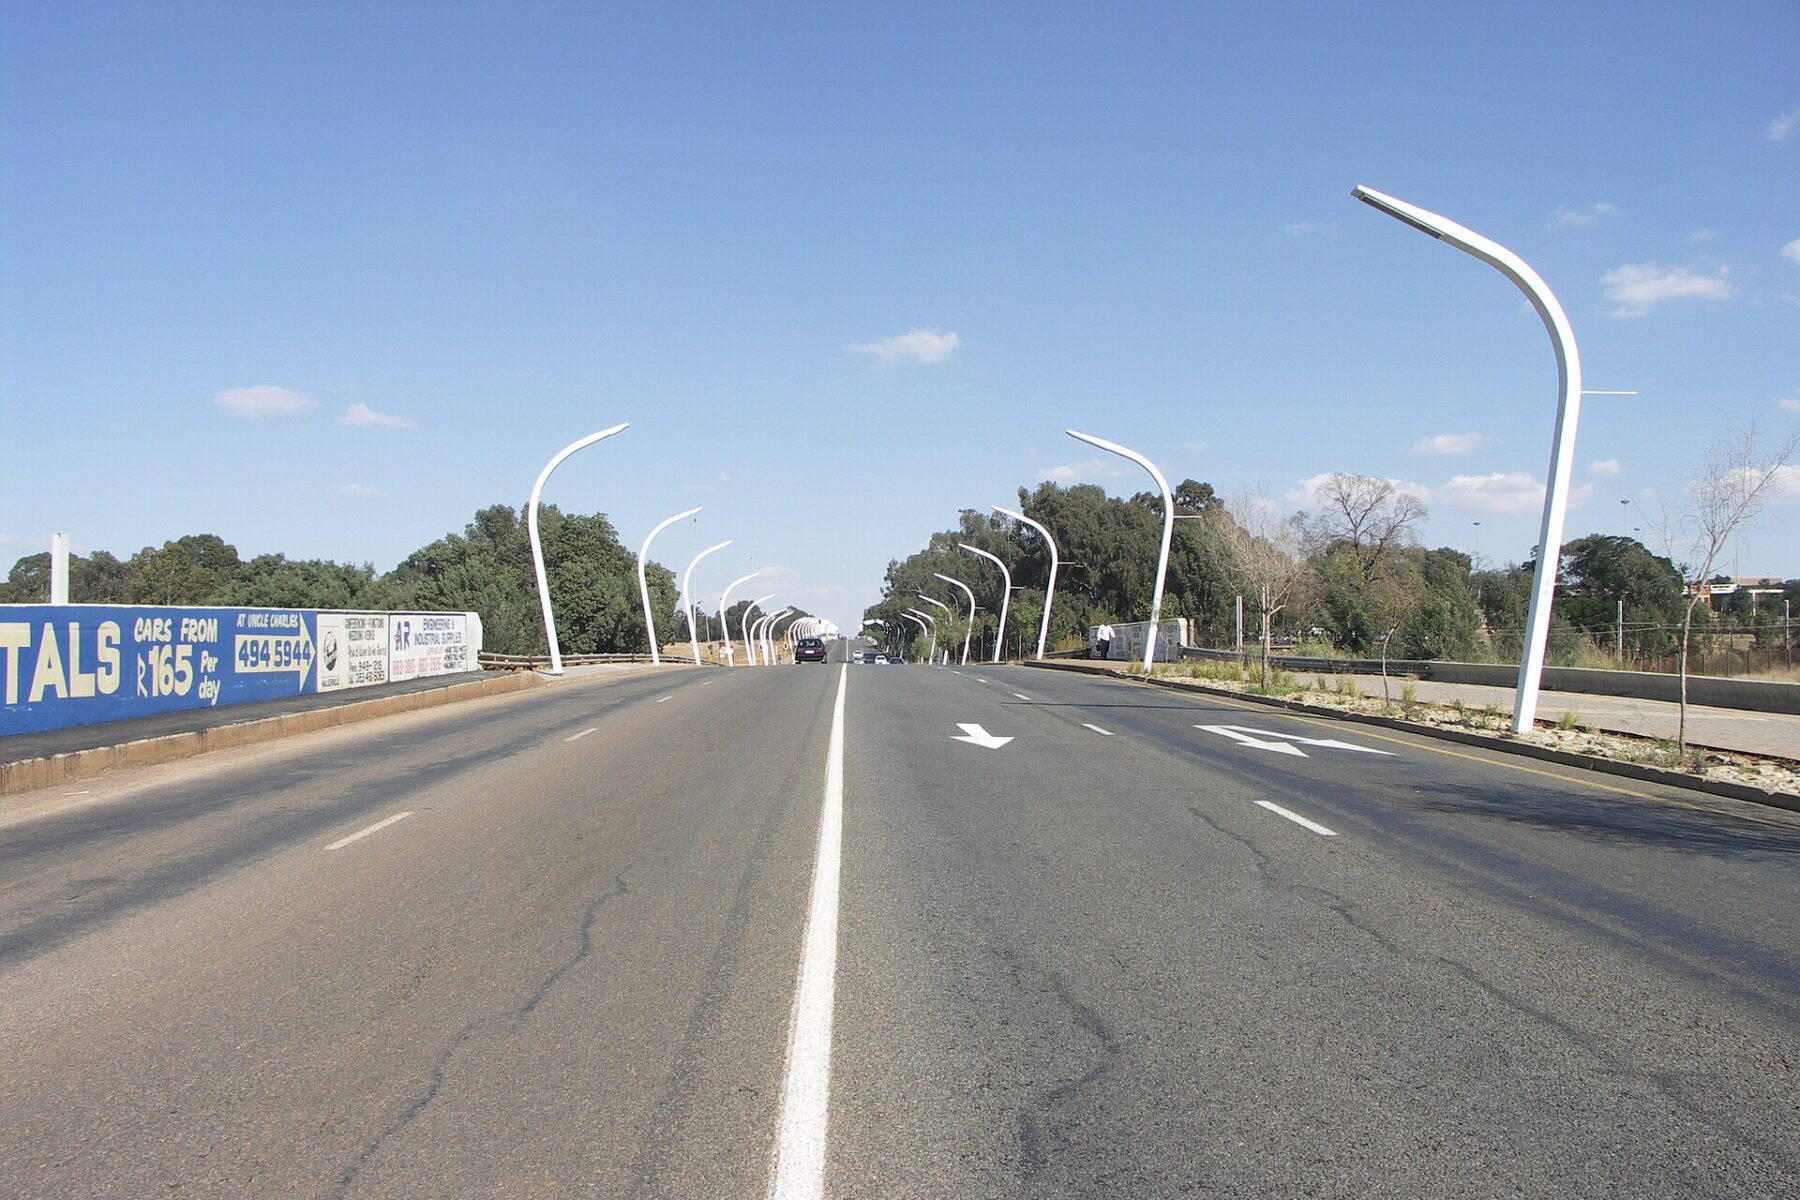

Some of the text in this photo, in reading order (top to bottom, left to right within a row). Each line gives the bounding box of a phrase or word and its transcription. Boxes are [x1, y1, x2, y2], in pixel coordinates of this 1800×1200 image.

[134, 617, 218, 643] CARS FROM
[236, 613, 246, 627] AT
[247, 613, 269, 627] UNCLE
[0, 621, 121, 704] TALS
[200, 650, 219, 674] Per
[238, 638, 311, 667] 494 5944
[198, 676, 220, 705] day
